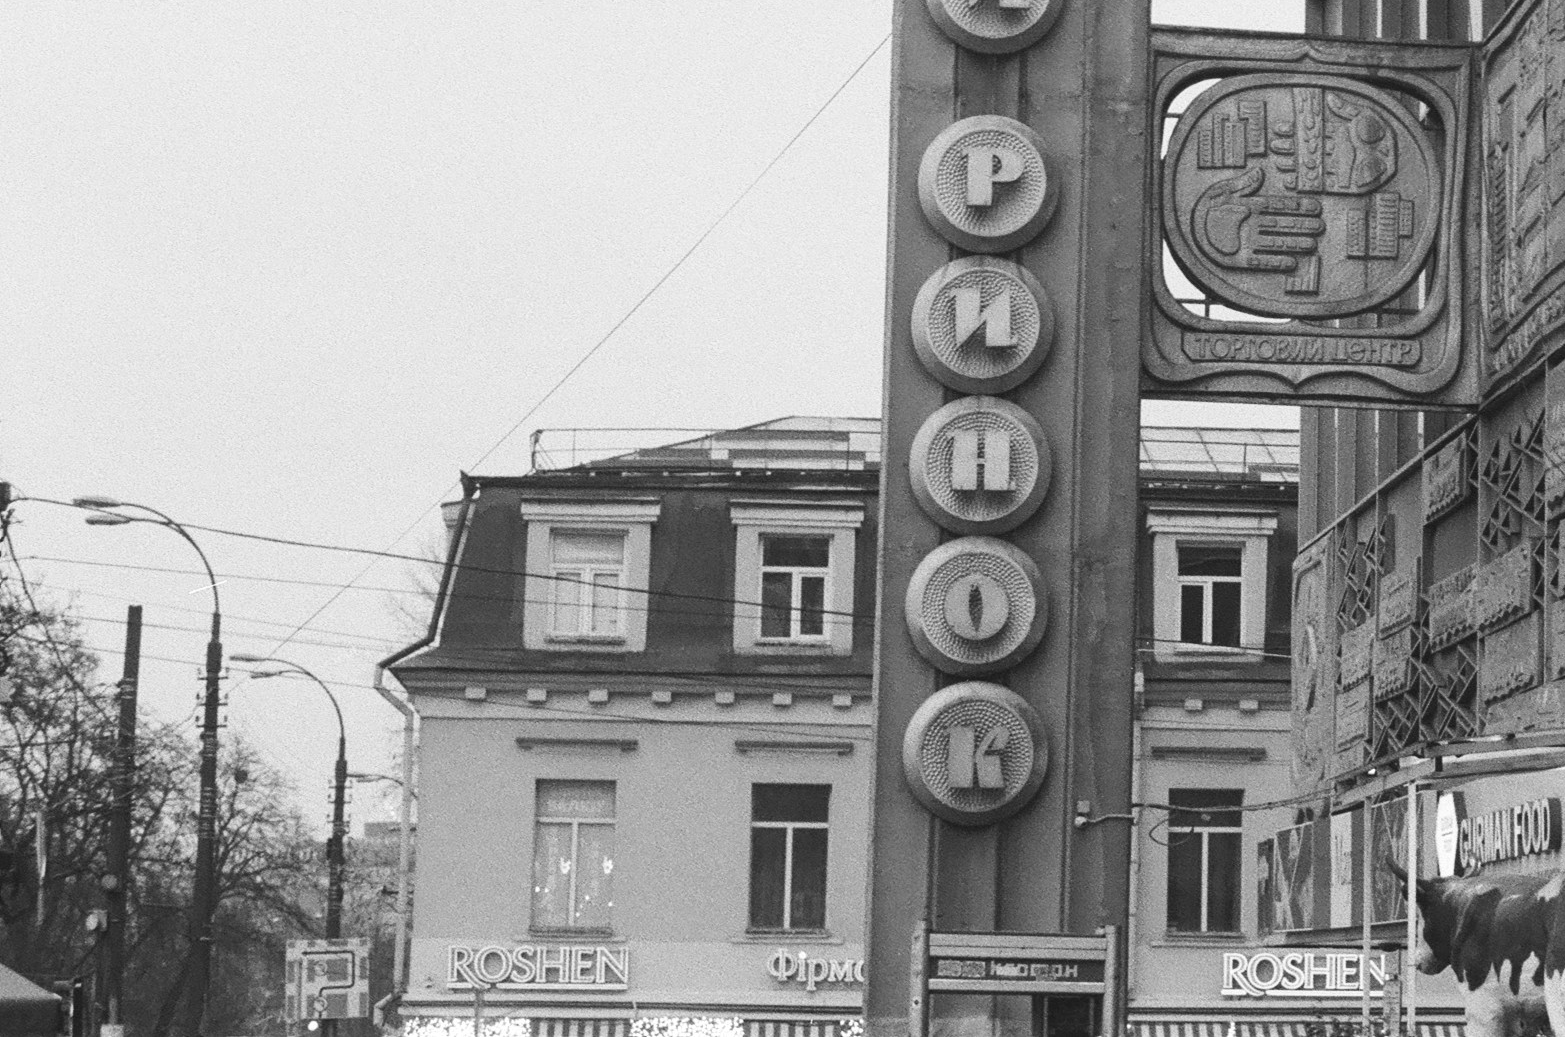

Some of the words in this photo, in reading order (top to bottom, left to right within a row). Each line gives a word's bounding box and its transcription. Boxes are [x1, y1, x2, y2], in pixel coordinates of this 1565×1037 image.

[940, 140, 1029, 796] РИНОК
[1460, 807, 1512, 869] GURMAN
[1513, 798, 1551, 858] FOOD
[447, 945, 630, 988] ROSHEN
[1222, 952, 1386, 997] ROSHEN
